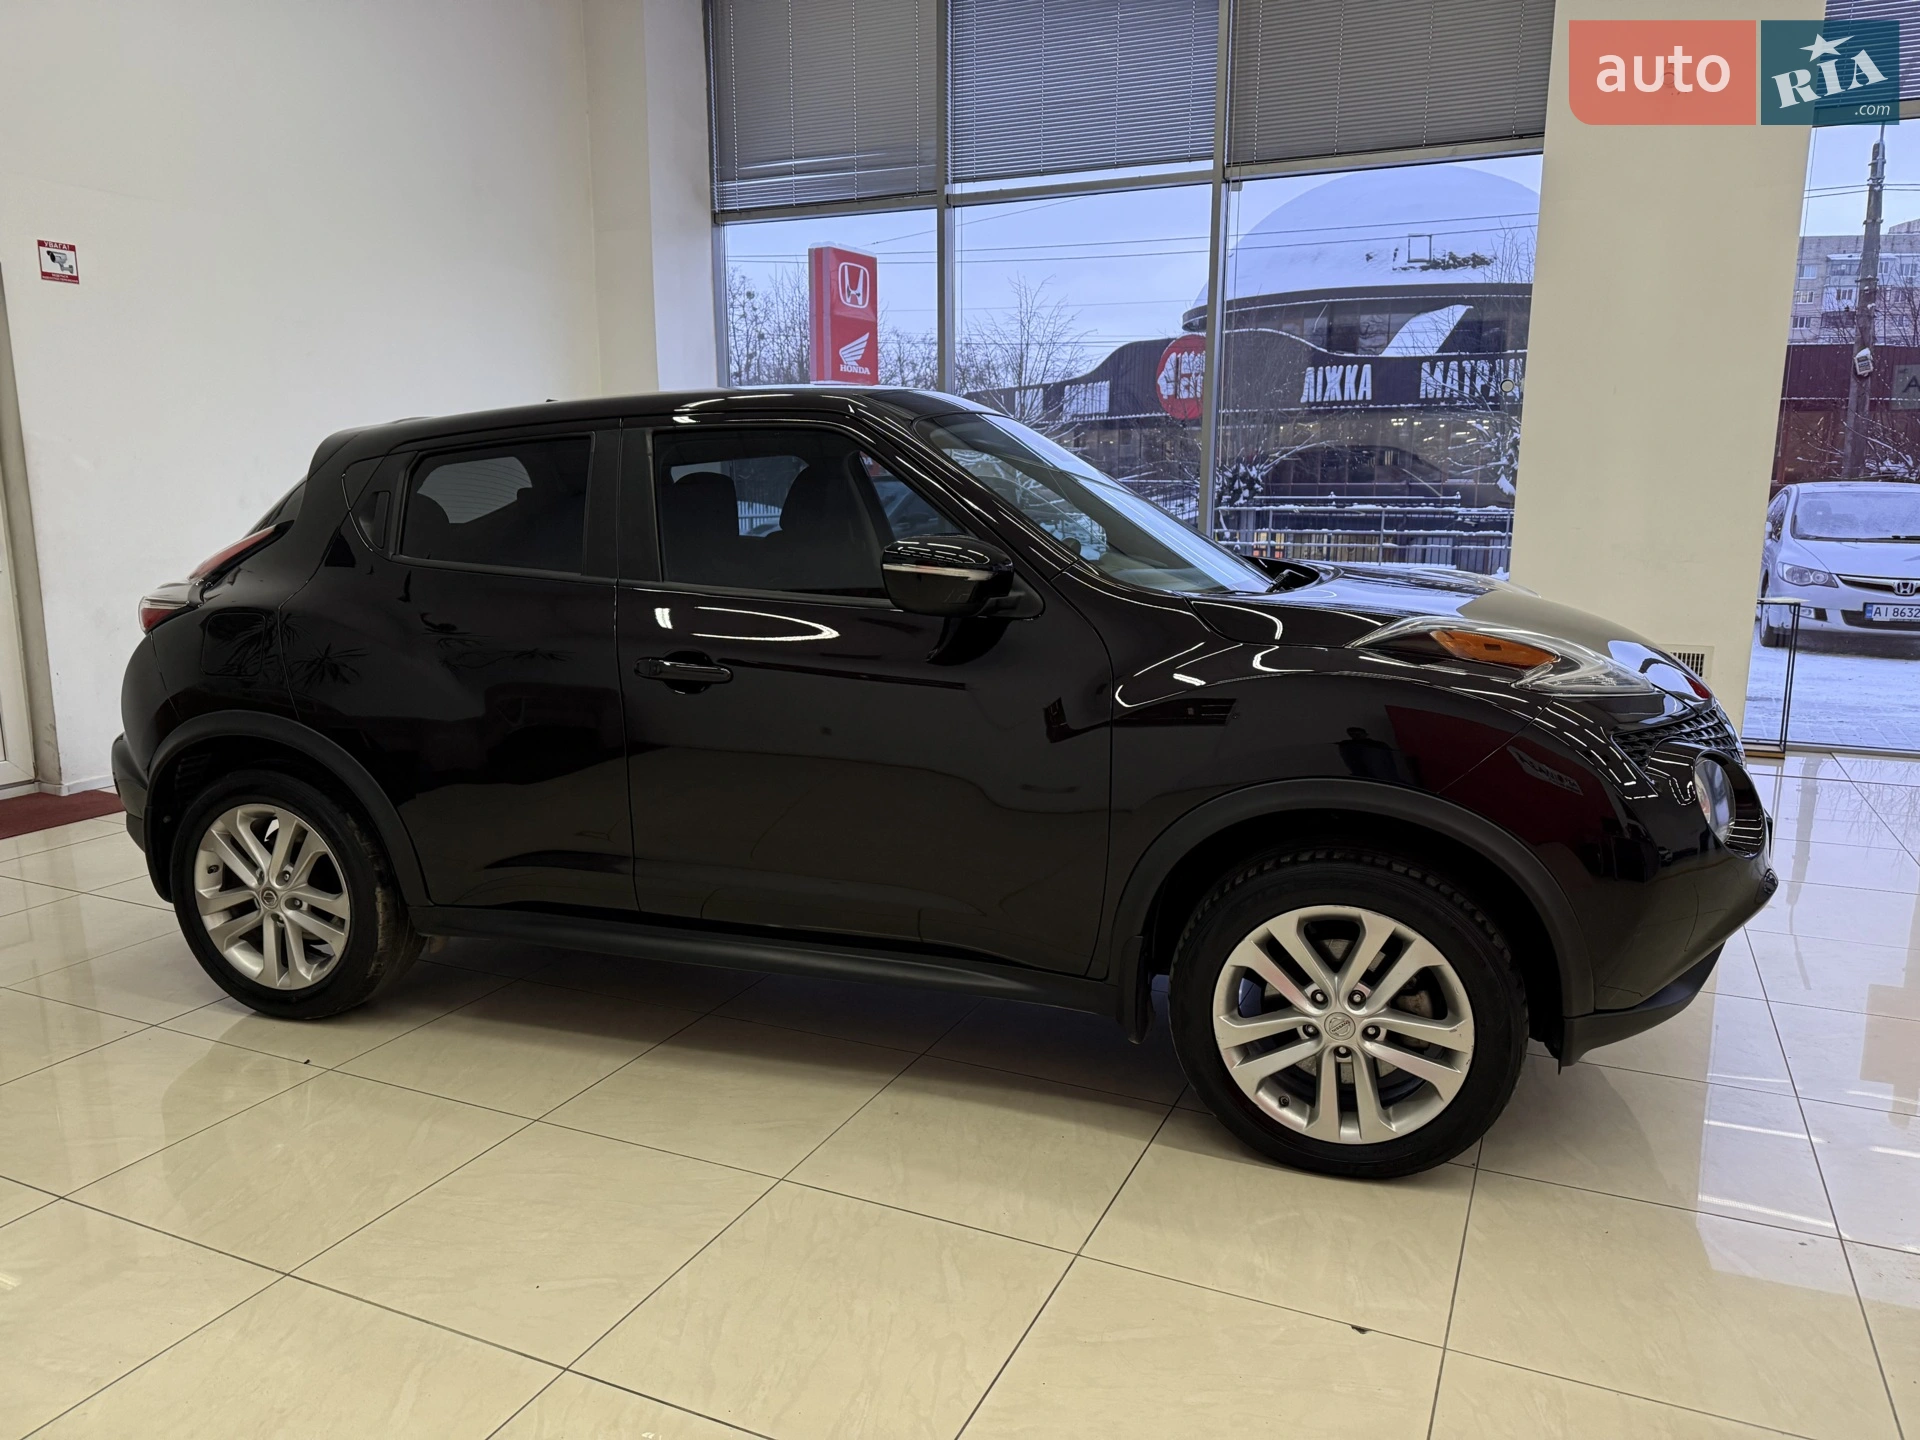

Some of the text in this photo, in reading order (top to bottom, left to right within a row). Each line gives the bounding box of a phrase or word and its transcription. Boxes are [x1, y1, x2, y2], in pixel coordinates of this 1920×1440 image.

[44, 241, 70, 250] УВАГА!
[840, 364, 871, 375] HONDA
[1301, 363, 1372, 403] ЛІЖКА
[1873, 606, 1920, 618] AI 8632
